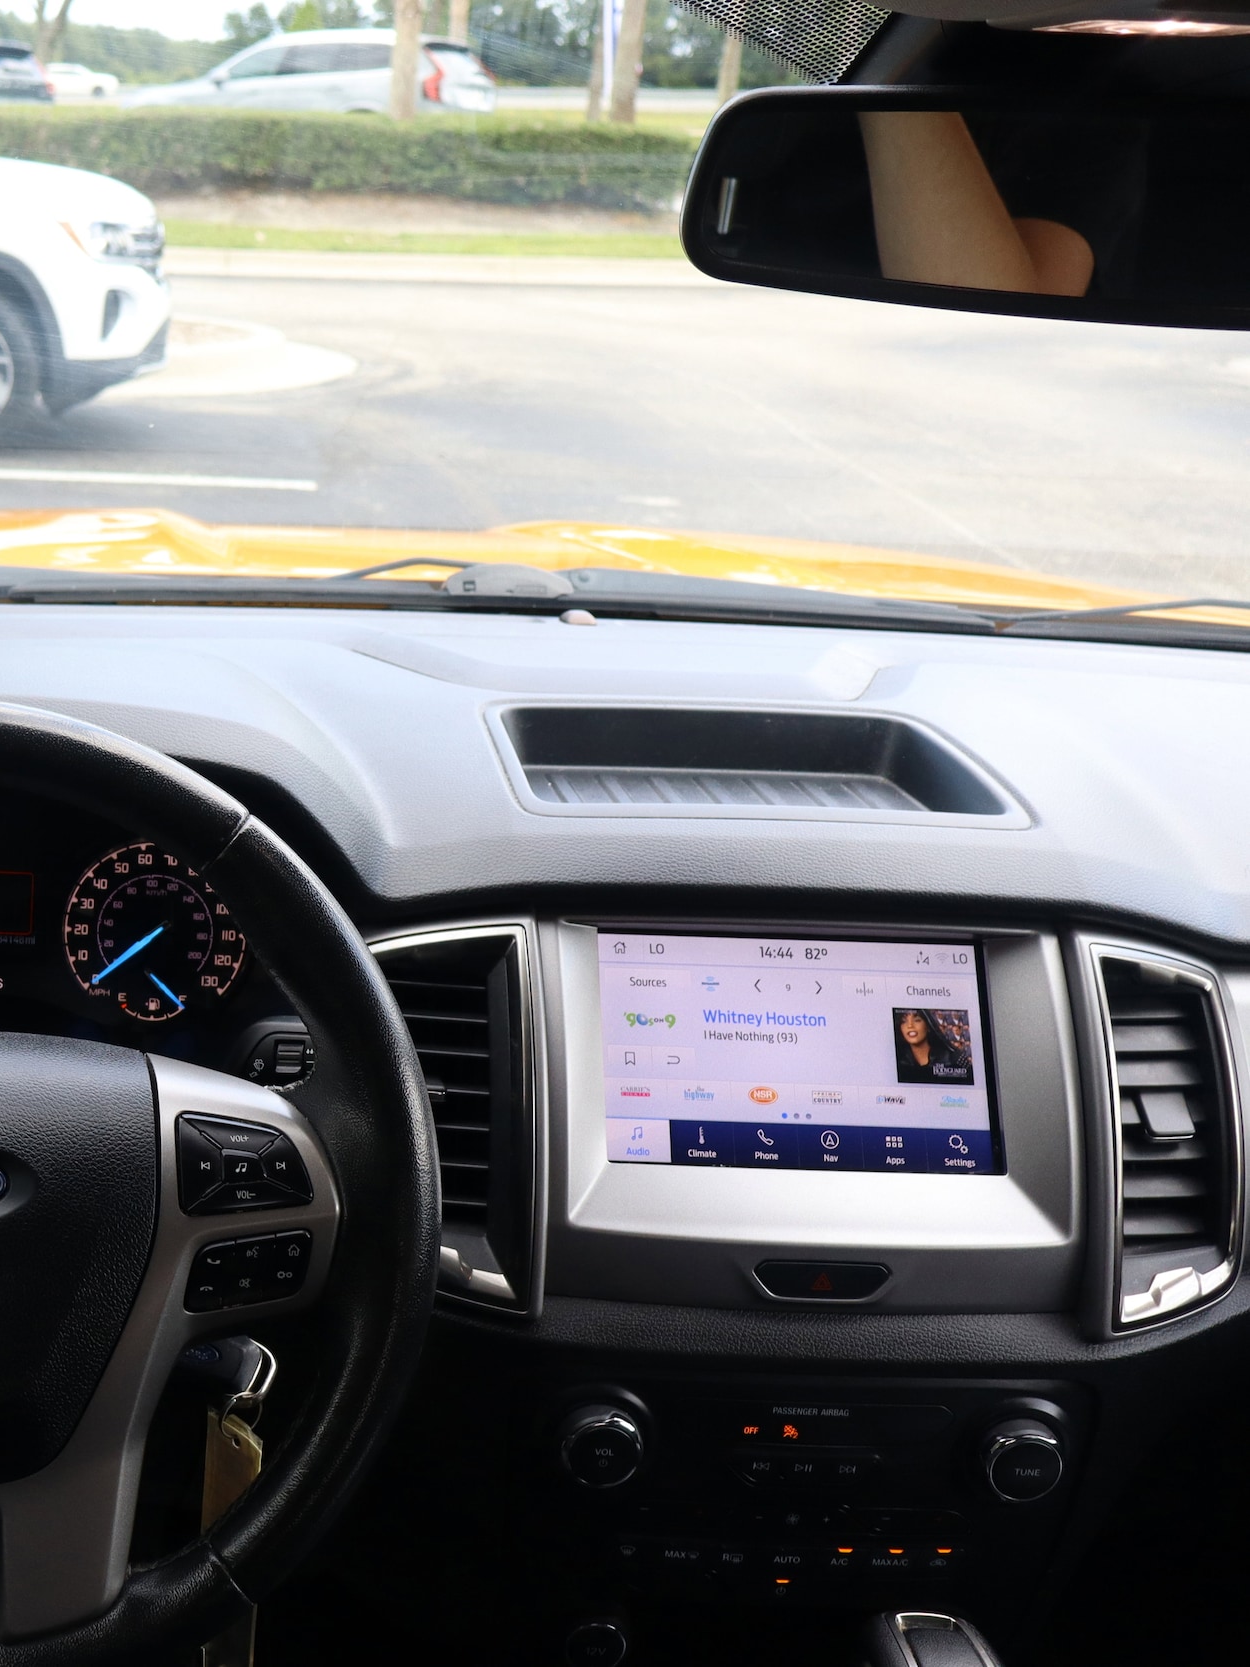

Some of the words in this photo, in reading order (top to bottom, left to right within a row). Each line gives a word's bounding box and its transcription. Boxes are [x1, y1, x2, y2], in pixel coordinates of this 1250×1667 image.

[138, 854, 152, 865] 60
[164, 854, 178, 866] 70
[114, 863, 129, 874] 50
[93, 879, 108, 890] 40
[167, 883, 178, 891] 120
[80, 898, 94, 909] 30
[74, 924, 88, 935] 20
[222, 930, 236, 941] 110
[649, 943, 665, 955] LO
[759, 946, 794, 959] 14:44
[78, 950, 88, 961] 10
[214, 955, 231, 966] 120
[952, 953, 968, 965] LO
[201, 976, 219, 987] 130
[629, 976, 667, 988] Sources
[784, 983, 791, 992] 9
[906, 985, 951, 997] Channels
[118, 993, 127, 1002] E
[703, 1009, 763, 1027] Whitney
[766, 1011, 827, 1027] Houston
[703, 1030, 707, 1040] I
[708, 1030, 734, 1041] Have
[735, 1031, 774, 1044] Nothing
[776, 1032, 798, 1044] (93)
[684, 1089, 715, 1101] highway
[753, 1090, 773, 1099] NSR
[626, 1147, 650, 1156] Audio
[688, 1149, 717, 1158] Climate
[755, 1151, 779, 1160] Phone
[823, 1154, 838, 1162] Nav
[886, 1156, 905, 1165] Apps
[945, 1158, 976, 1168] Settings
[772, 1407, 818, 1416] PASSENGER
[821, 1409, 849, 1417] AIRBAG
[743, 1426, 759, 1434] OFF
[595, 1448, 614, 1456] VOL
[1014, 1468, 1040, 1476] TUNE
[664, 1550, 687, 1559] MAX
[773, 1555, 800, 1564] AUTO
[830, 1557, 849, 1566] A/C
[872, 1558, 892, 1567] MAX
[892, 1558, 910, 1567] A/C
